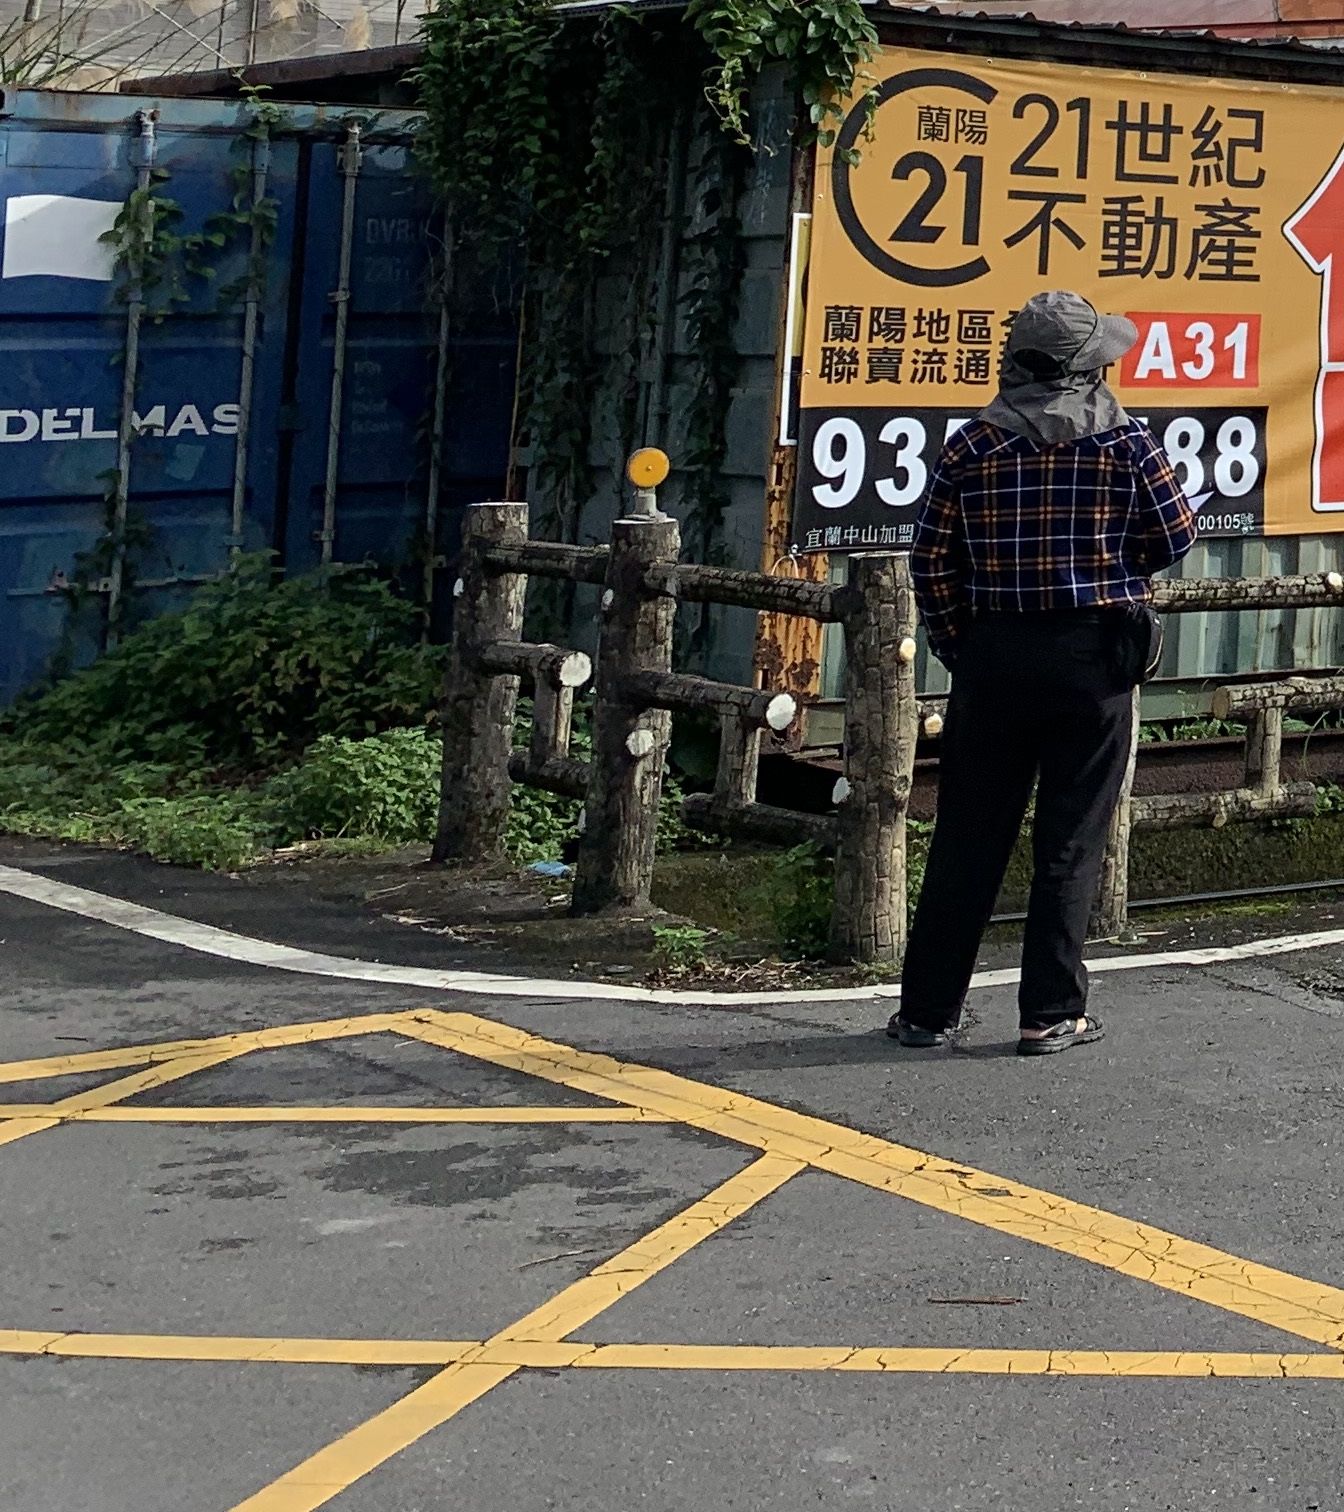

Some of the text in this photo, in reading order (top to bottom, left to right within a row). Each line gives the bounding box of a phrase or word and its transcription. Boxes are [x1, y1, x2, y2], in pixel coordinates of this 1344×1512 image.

[917, 104, 988, 145] 蘭陽
[1010, 93, 1266, 190] 21世紀
[888, 151, 985, 246] 21
[1003, 189, 1262, 282] 不動產
[824, 305, 1018, 345] 蘭陽地區
[819, 346, 1004, 386] 聯賣流通
[1134, 322, 1249, 380] A31
[0, 403, 242, 443] DELMAS
[805, 524, 915, 549] 宜蘭中山加盟
